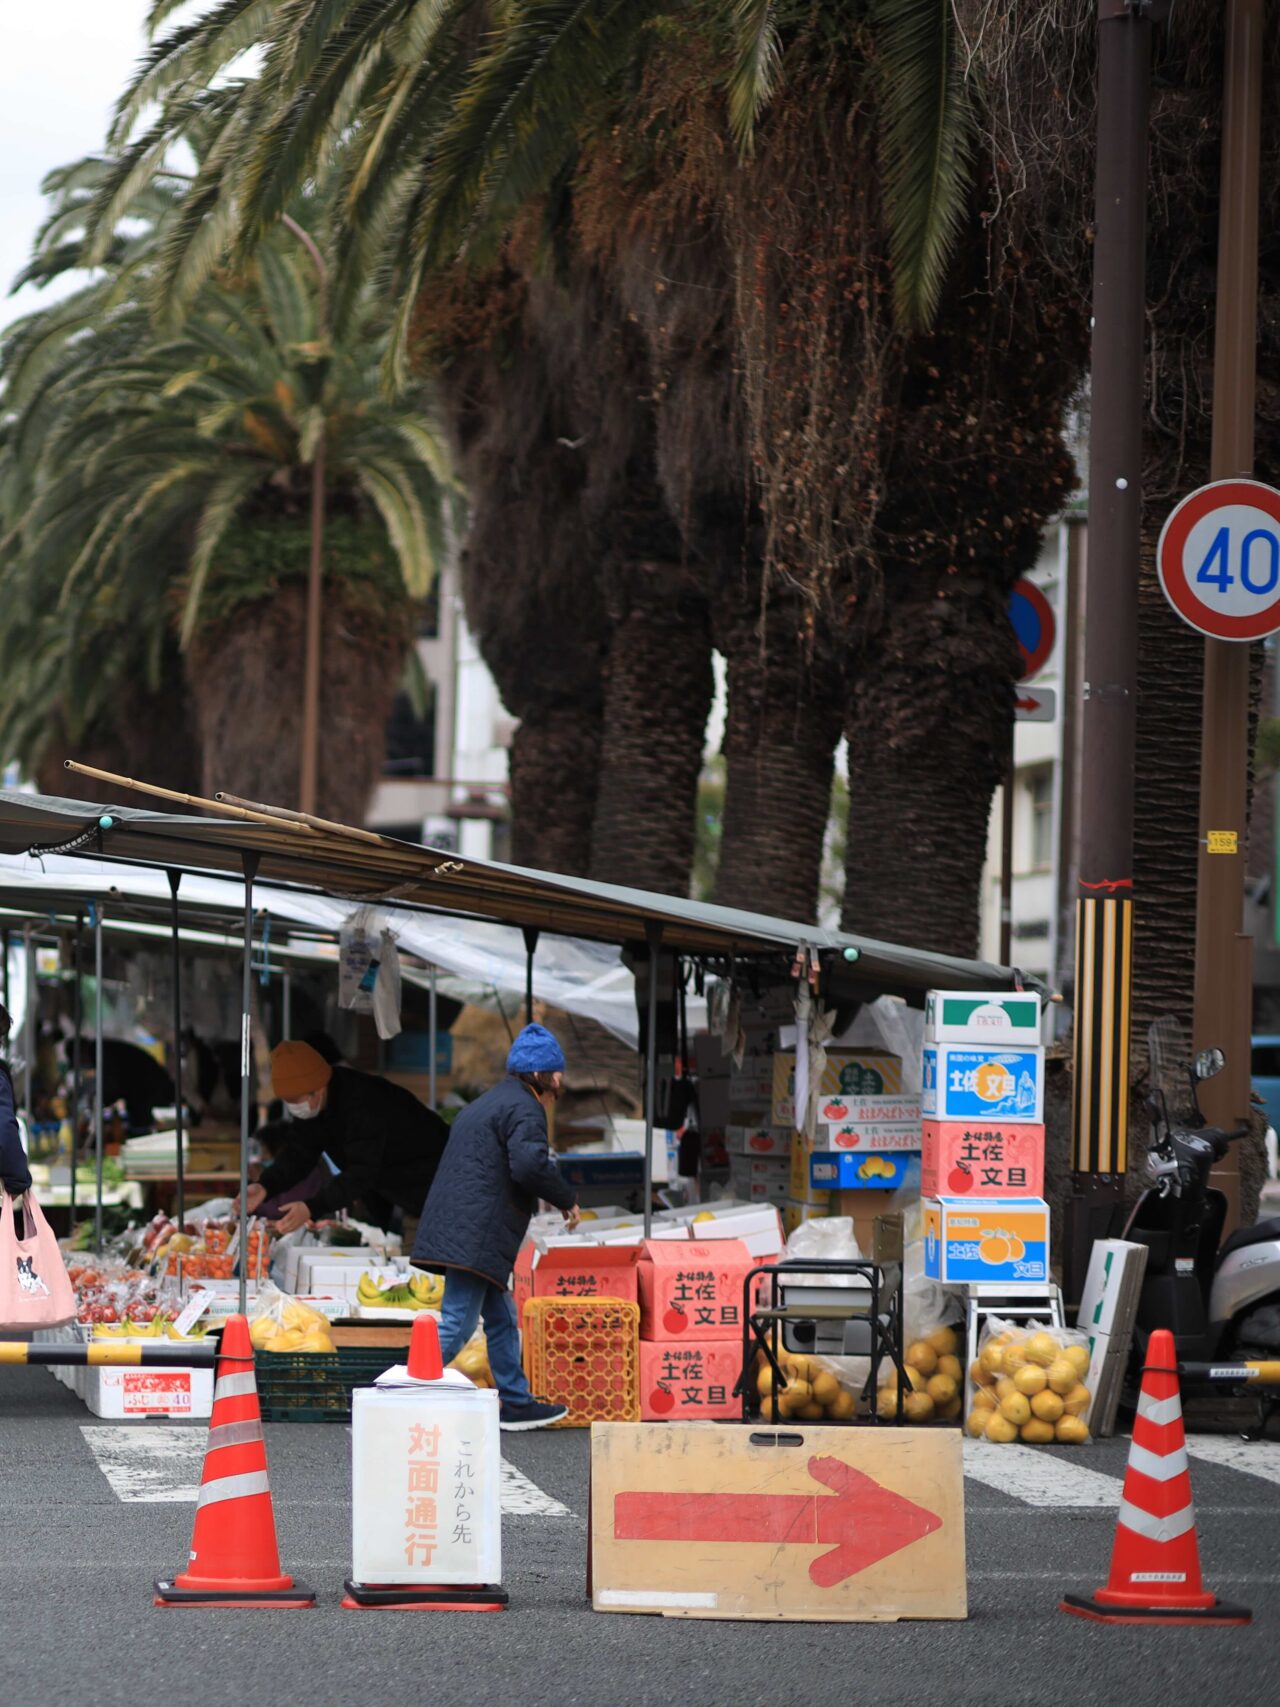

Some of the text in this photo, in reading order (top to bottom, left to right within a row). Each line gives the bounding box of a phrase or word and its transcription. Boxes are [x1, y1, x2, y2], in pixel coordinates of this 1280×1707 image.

[1197, 526, 1280, 595] 40
[949, 1069, 1017, 1097] 土佐 文旦
[869, 1134, 922, 1148] まほろばト
[960, 1143, 1004, 1161] 土佐
[980, 1167, 1027, 1187] 文旦
[948, 1242, 980, 1260] 土佐
[1013, 1261, 1045, 1279] 文旦
[674, 1283, 717, 1301] 土佐
[694, 1306, 740, 1325] 文旦
[660, 1363, 704, 1380] 土佐
[681, 1386, 727, 1405] 文旦
[404, 1422, 442, 1568] 対面通行
[451, 1440, 475, 1544] これから先
